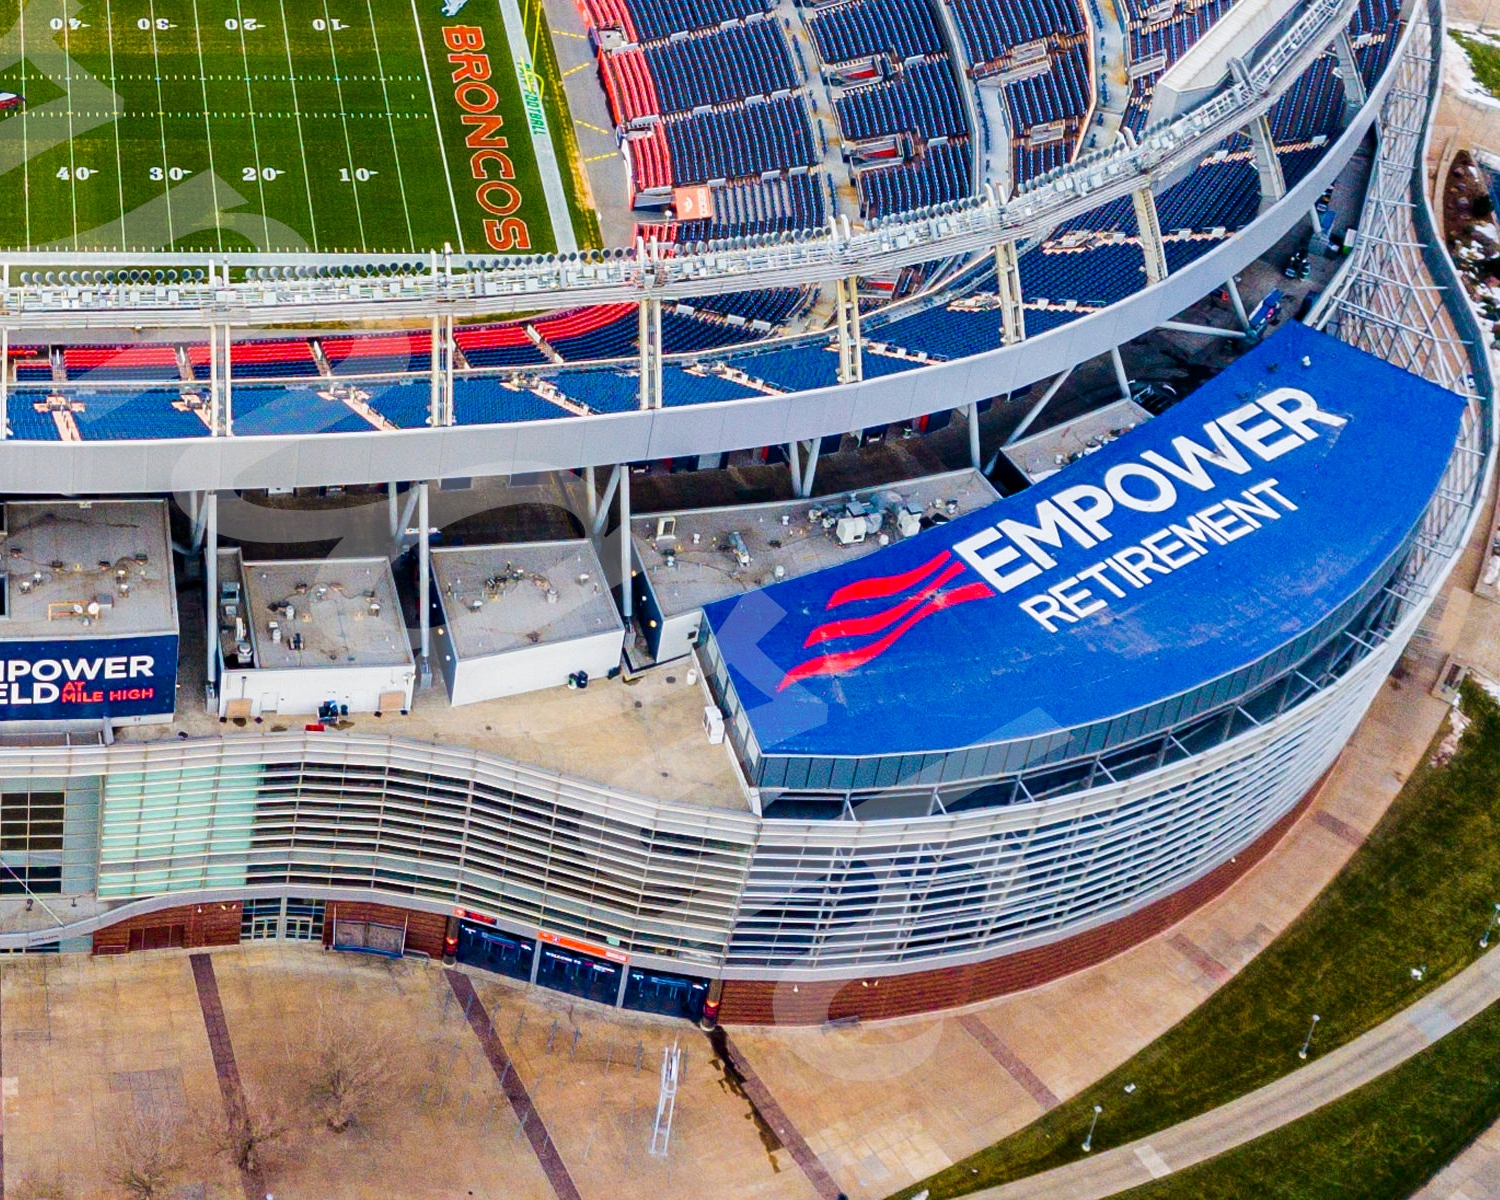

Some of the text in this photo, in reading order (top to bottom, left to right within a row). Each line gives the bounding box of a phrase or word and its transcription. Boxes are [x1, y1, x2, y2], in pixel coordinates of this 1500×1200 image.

[49, 17, 81, 30] 40
[137, 17, 169, 30] 30
[224, 17, 257, 30] 20
[312, 17, 342, 30] 10
[443, 24, 532, 252] BRONCOS
[56, 166, 88, 181] 40
[149, 166, 182, 181] 30
[242, 166, 276, 181] 20
[339, 166, 370, 181] 10
[952, 387, 1348, 594] EMPOWER
[1019, 478, 1298, 633] RETIREMENT
[62, 681, 86, 693] AT
[61, 687, 154, 703] MILE HIGH
